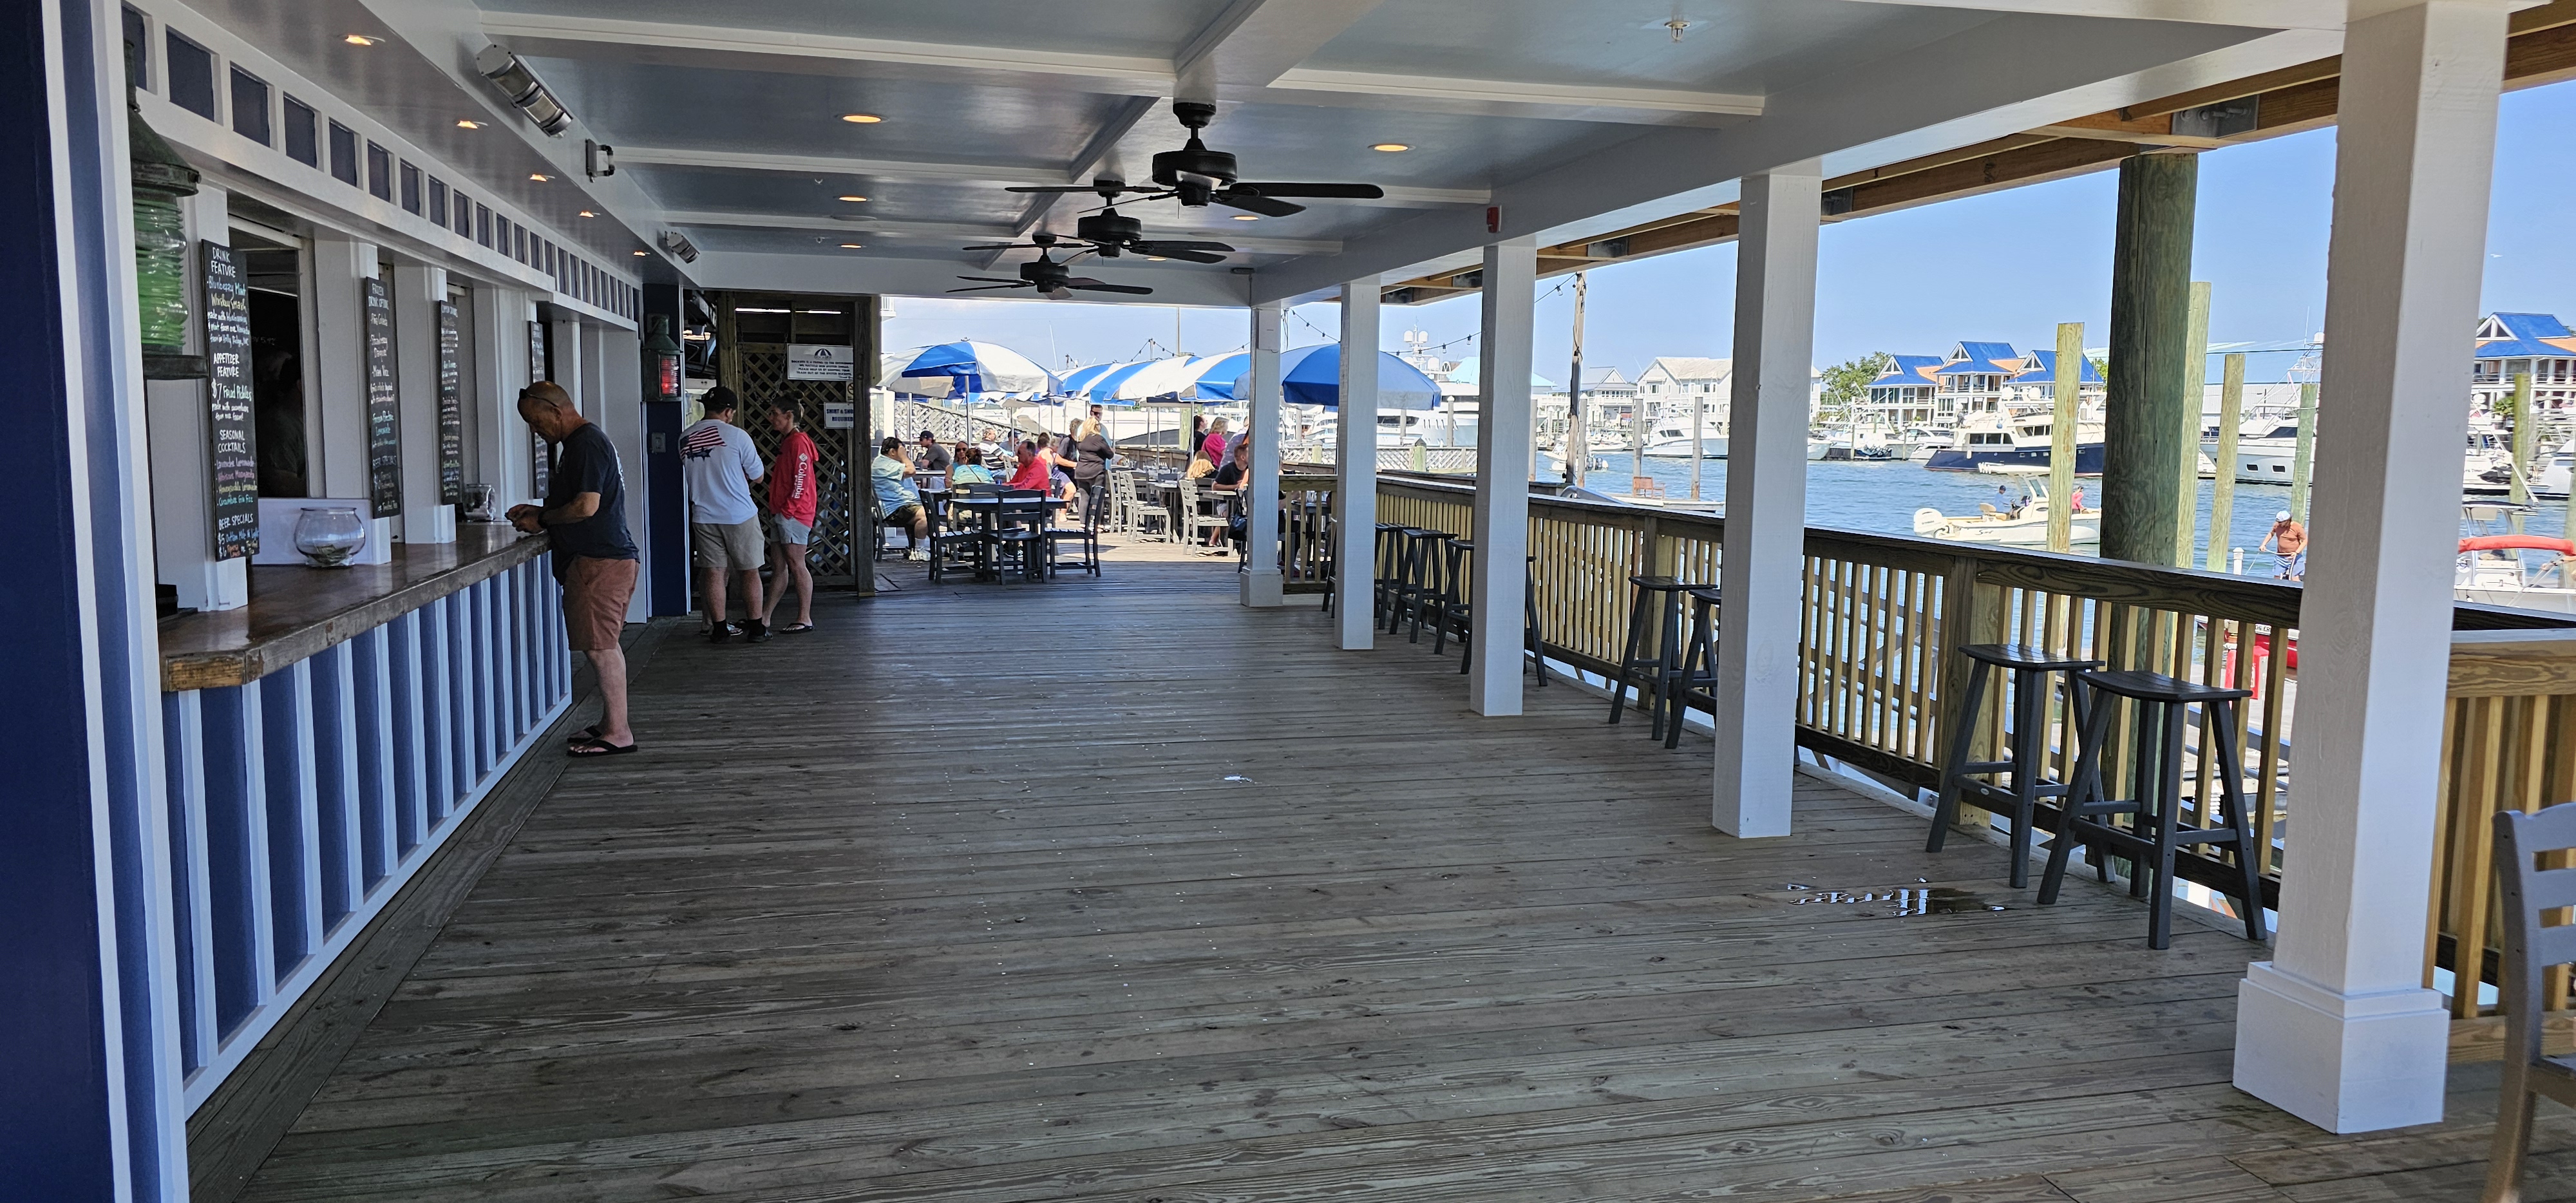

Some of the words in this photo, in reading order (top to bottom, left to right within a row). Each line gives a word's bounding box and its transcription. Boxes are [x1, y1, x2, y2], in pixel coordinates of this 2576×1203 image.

[212, 247, 231, 263] DRINK
[211, 260, 236, 278] FEATURE
[213, 352, 240, 365] APPETIZER
[217, 366, 239, 377] FEATURE
[211, 377, 222, 401] $7
[223, 383, 236, 399] Fried
[236, 384, 252, 402] Pickles
[220, 429, 245, 440] SEASONAL
[218, 442, 246, 454] COCKTAILS
[236, 455, 254, 467] Lemonade
[794, 462, 808, 499] Columbia
[219, 517, 231, 531] BEER
[232, 513, 254, 526] SPECIALS
